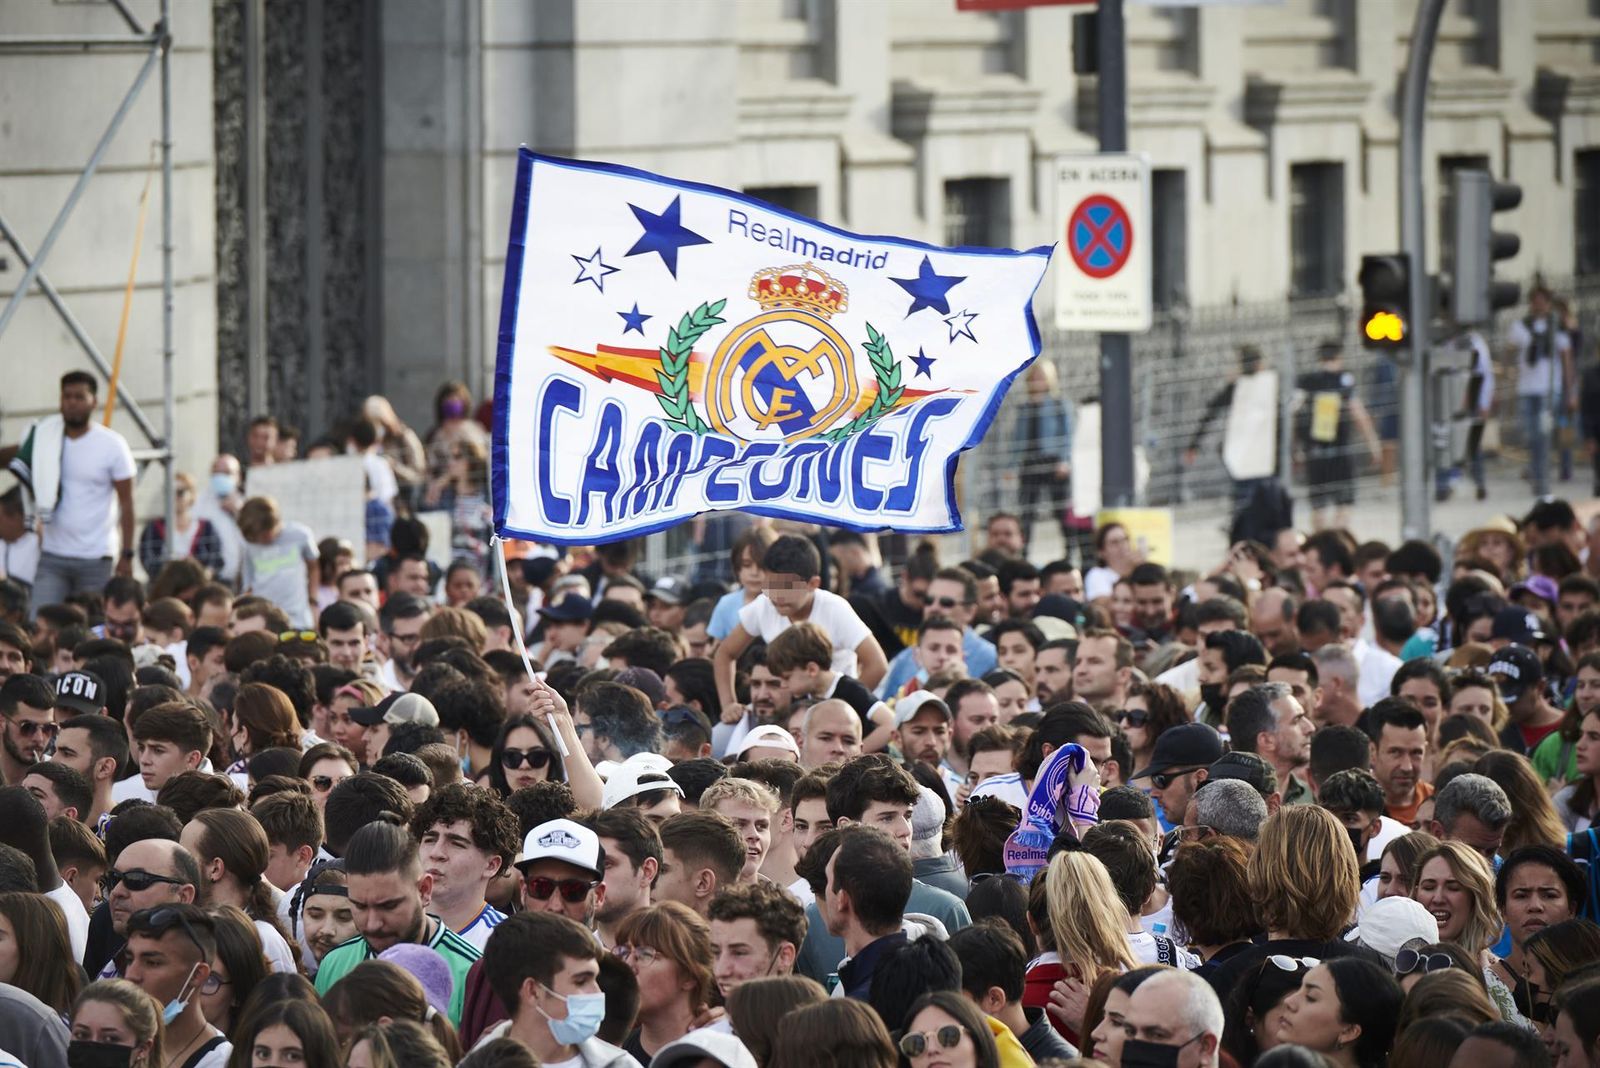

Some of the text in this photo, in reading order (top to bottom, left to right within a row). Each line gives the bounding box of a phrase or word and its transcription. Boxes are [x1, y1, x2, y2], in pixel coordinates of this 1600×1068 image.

[728, 209, 888, 269] Realmadrid
[536, 375, 964, 527] CAMPEONES
[56, 675, 97, 700] ICON
[1007, 848, 1047, 861] Realma
